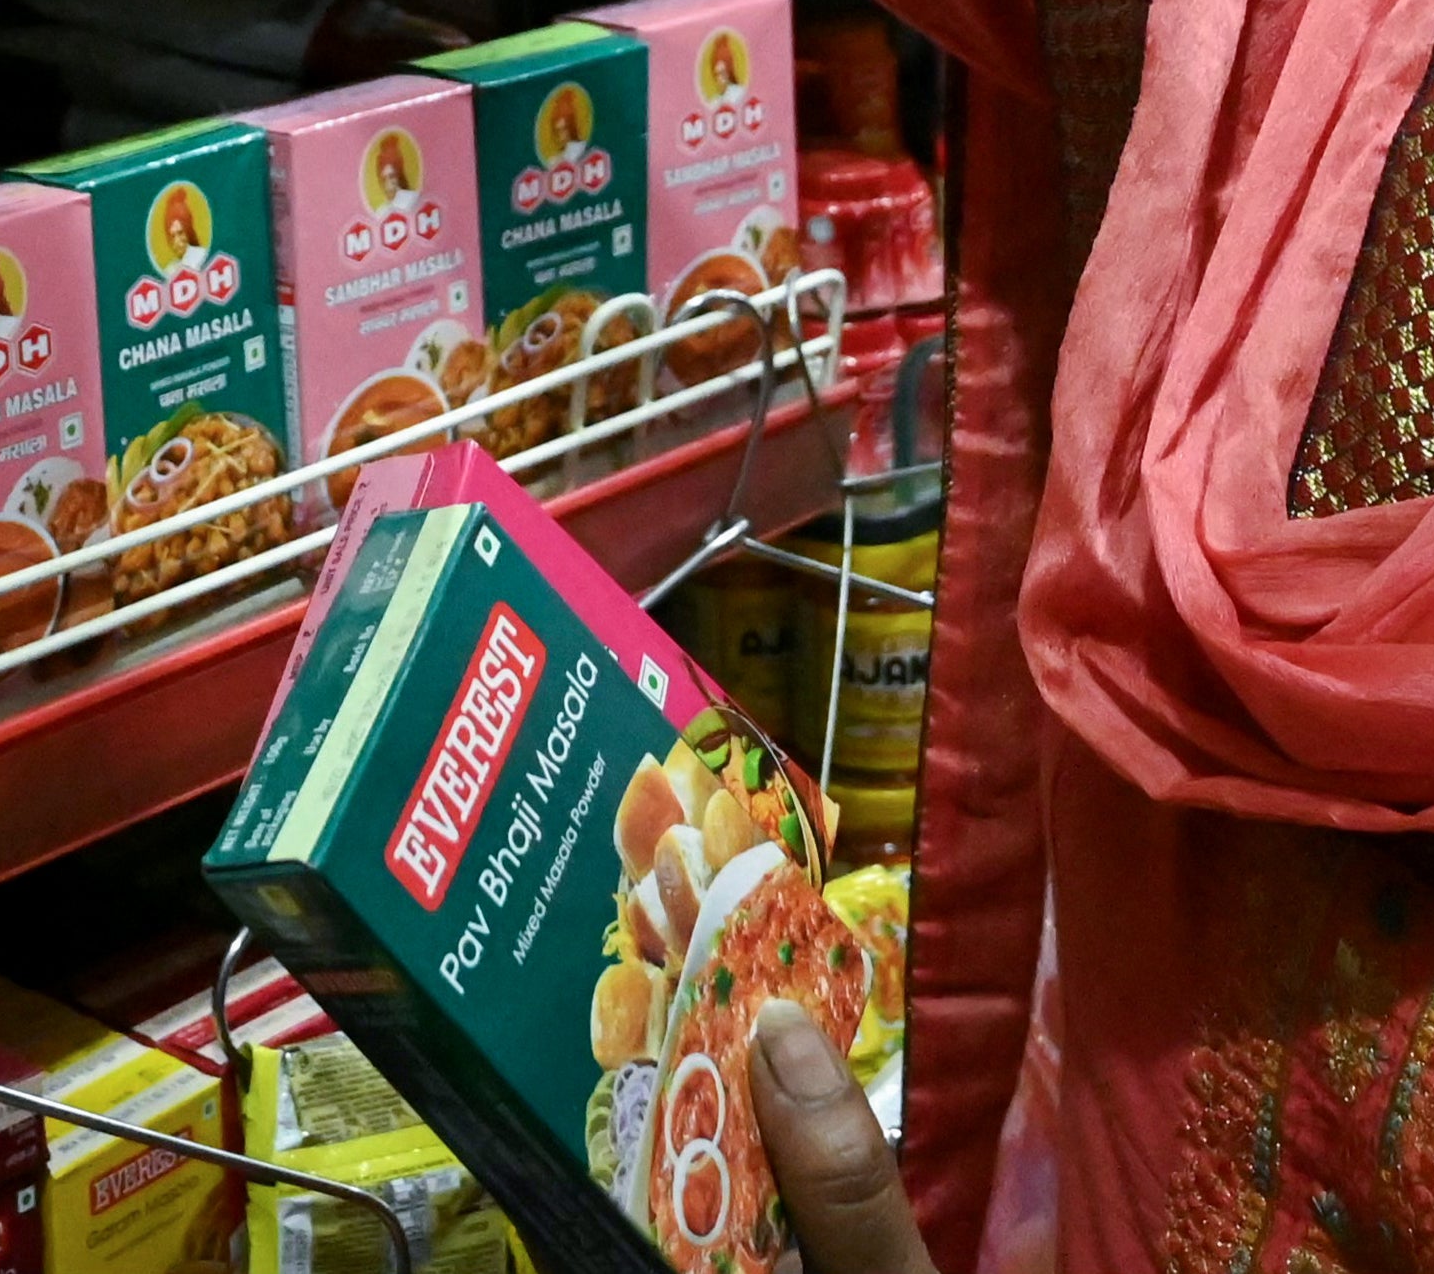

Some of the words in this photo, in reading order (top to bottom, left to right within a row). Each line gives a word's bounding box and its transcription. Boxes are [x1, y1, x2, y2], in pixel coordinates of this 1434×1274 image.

[5, 376, 80, 420] MASALA
[117, 330, 184, 372] CHANA
[184, 306, 255, 350] MASALA
[390, 614, 540, 899] EVEREST
[440, 902, 491, 997] Pav
[479, 780, 546, 911] Bhaji
[533, 651, 601, 794] Masala
[512, 905, 547, 968] Mixed
[541, 828, 581, 906] Masala
[571, 751, 609, 828] Powder
